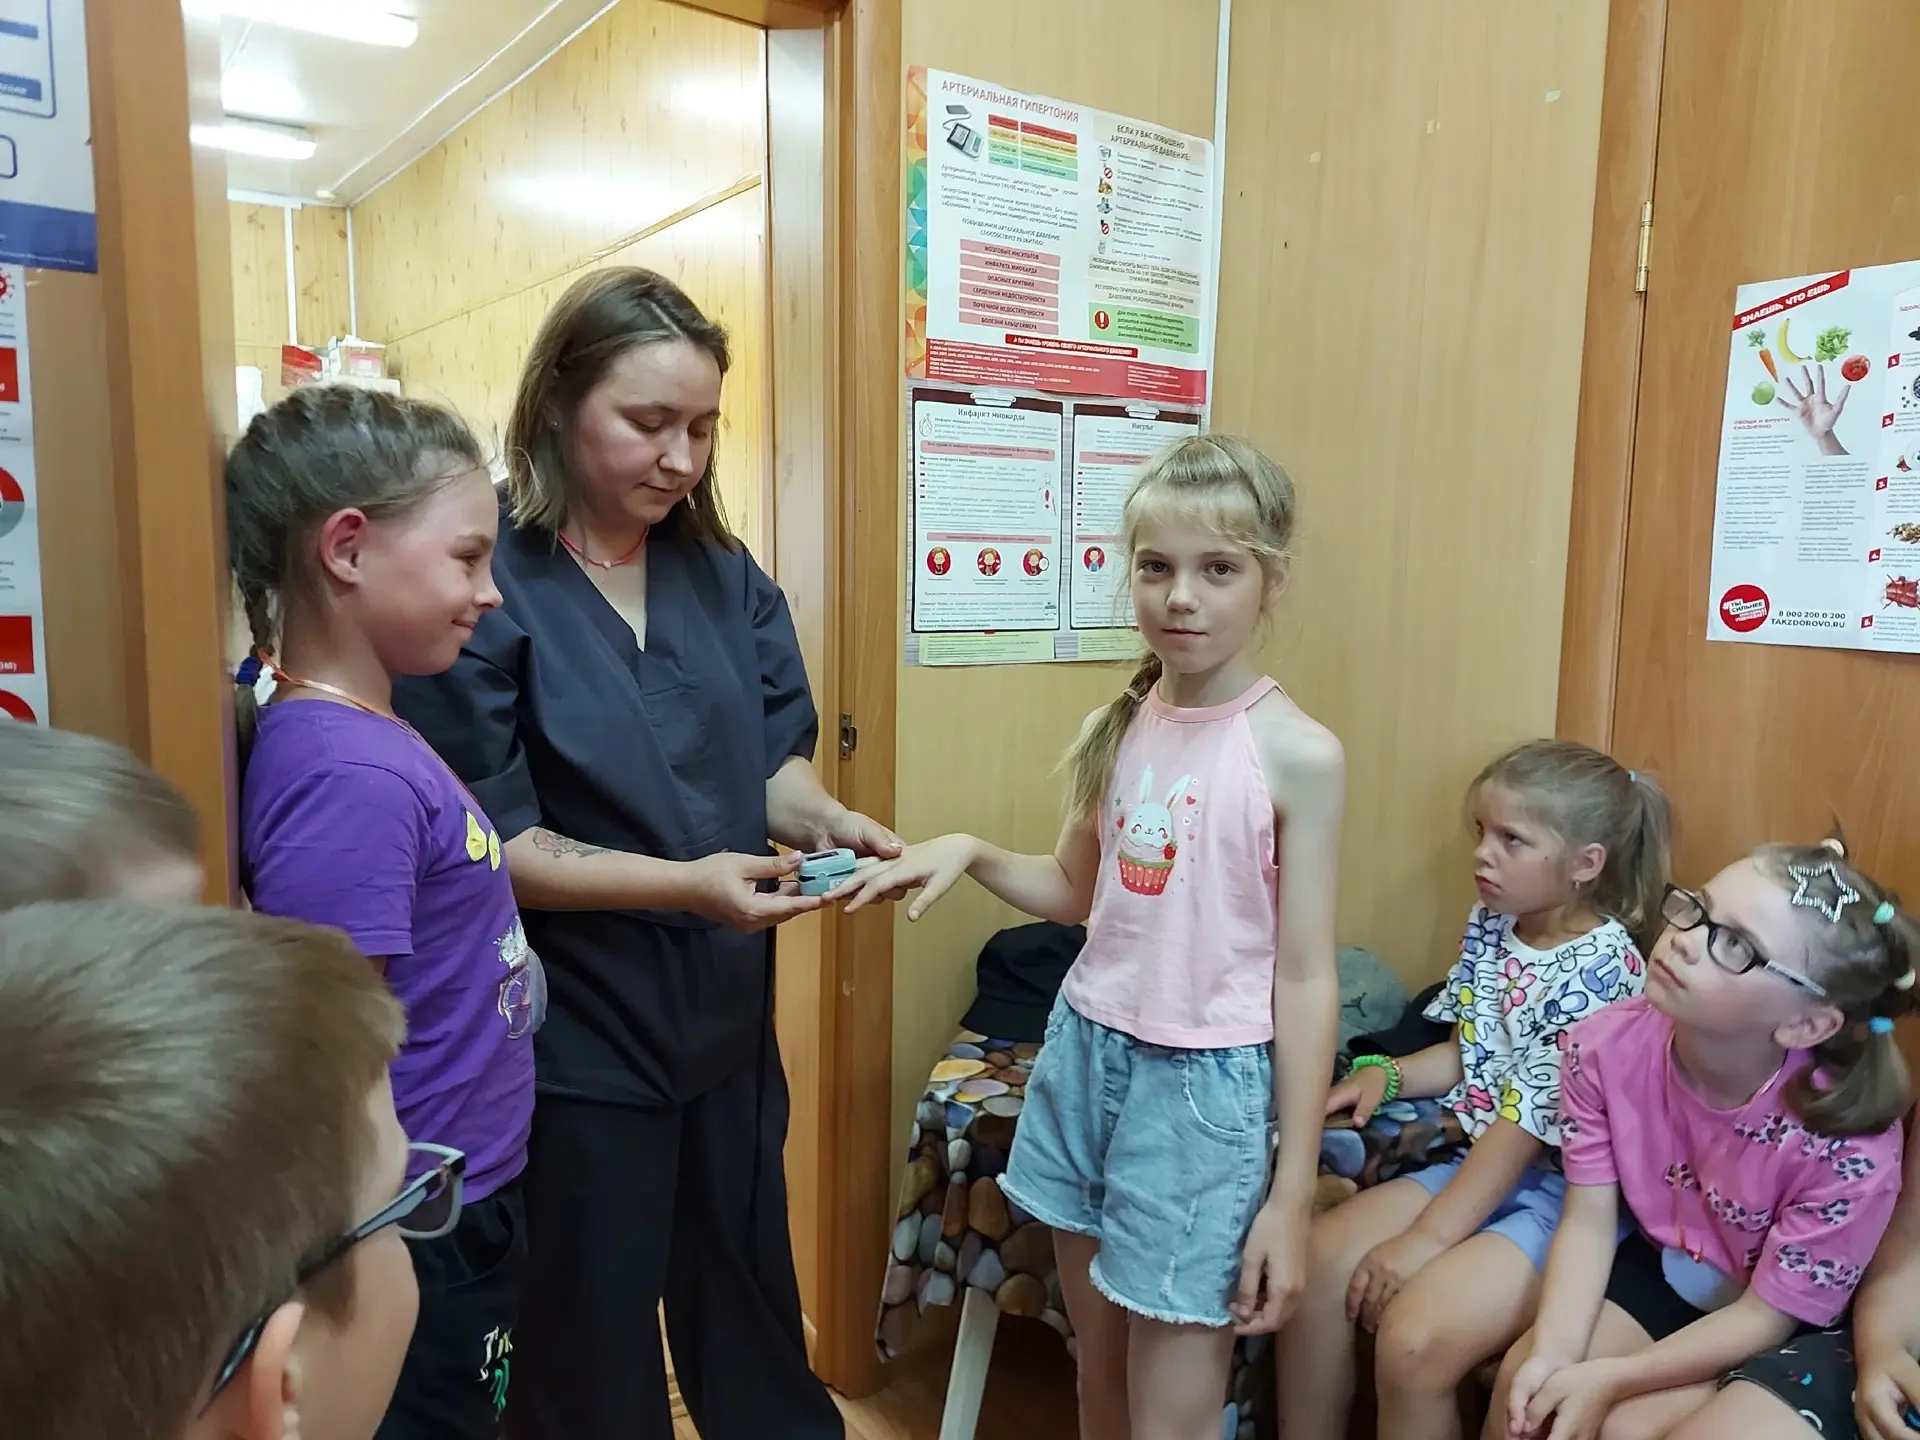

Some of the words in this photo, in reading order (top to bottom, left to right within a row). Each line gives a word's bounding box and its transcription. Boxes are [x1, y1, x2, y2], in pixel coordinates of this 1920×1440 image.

[942, 80, 1018, 106] АРТЕРИАЛЬНАЯ
[1020, 99, 1079, 122] ГИПЕРТОНИЯ
[1141, 130, 1153, 139] ВАС
[1111, 135, 1158, 153] АРТЕРИАЛЬНОЕ
[984, 246, 1011, 255] МОЗГОВЫХ
[1012, 250, 1039, 260] ИНСУЛЬТОВ
[985, 260, 1010, 270] ИНФАРКТА
[1011, 265, 1037, 274] МИОКАРДА
[987, 275, 1011, 284] ОПАСНЫХ
[1012, 279, 1035, 287] АРИТМИЙ
[973, 287, 1001, 296] СЕРДЕЧНОЙ
[1002, 292, 1046, 304] НЕДОСТАТОЧНОСТИ
[973, 301, 999, 310] ПОЧЕЧНОЙ
[1000, 305, 1044, 317] НЕДОСТАТОЧНОСТИ
[1740, 303, 1784, 324] ЗНАЕШЬ,
[1785, 293, 1806, 305] ЧТО
[1807, 284, 1830, 298] ЕШЬ
[958, 408, 990, 418] Инфаркт
[992, 412, 1025, 422] миокарда
[1132, 423, 1154, 431] Инсульт
[1731, 602, 1763, 613] СИЛЬНЕЕ
[1770, 619, 1845, 630] TAKZDOROVO.RU
